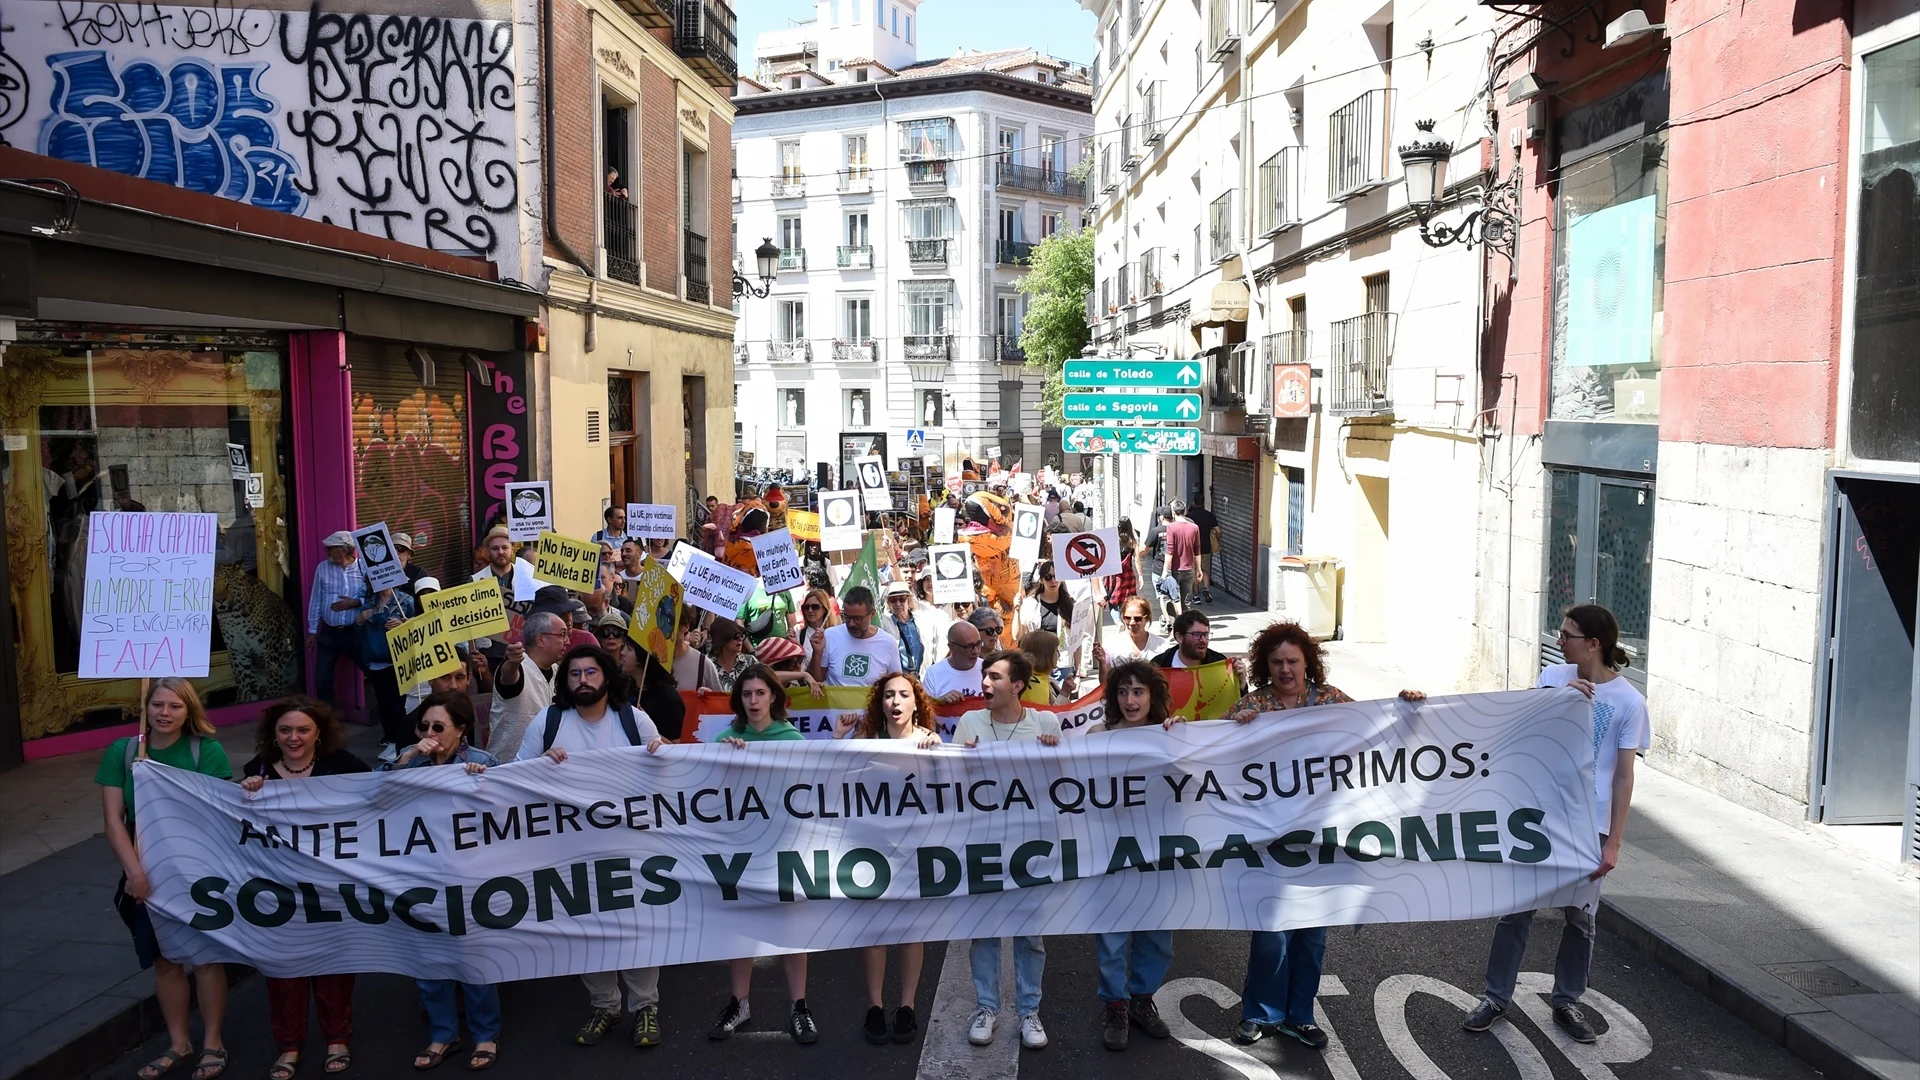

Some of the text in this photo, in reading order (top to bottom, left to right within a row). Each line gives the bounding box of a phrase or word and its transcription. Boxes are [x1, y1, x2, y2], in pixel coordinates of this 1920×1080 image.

[1068, 368, 1154, 379] calle de Toledo
[483, 361, 528, 415] he
[1067, 402, 1158, 415] calle de Segovia
[630, 510, 636, 518] La
[637, 510, 645, 519] UE,
[91, 513, 213, 555] ESCUCHA CAPITAL
[636, 523, 652, 532] cambio
[540, 538, 596, 563] ¡No hay un
[756, 550, 765, 560] We
[109, 556, 160, 574] POR
[537, 559, 594, 584] PLANeta B!
[762, 557, 789, 572] not Earth.
[689, 562, 745, 594] La UE, pro víctimas
[762, 571, 781, 588] Planet
[85, 578, 101, 614] LA
[107, 577, 155, 614] MADRE
[470, 588, 499, 602] clima,
[681, 579, 738, 612] del cambio climático.
[87, 613, 210, 634] SE ENCUENTRA
[450, 603, 502, 627] decisión!
[391, 618, 443, 662] ¡No hay un
[95, 636, 209, 674] FATAL
[398, 641, 454, 685] PLANeta B!
[239, 742, 1490, 860] ANTE LA EMERGENCIA CLIMÁTICA QUE YA SUFRIMOS:
[190, 855, 682, 936] SOLUCIONES
[702, 852, 752, 901] Y
[777, 848, 891, 902] NO
